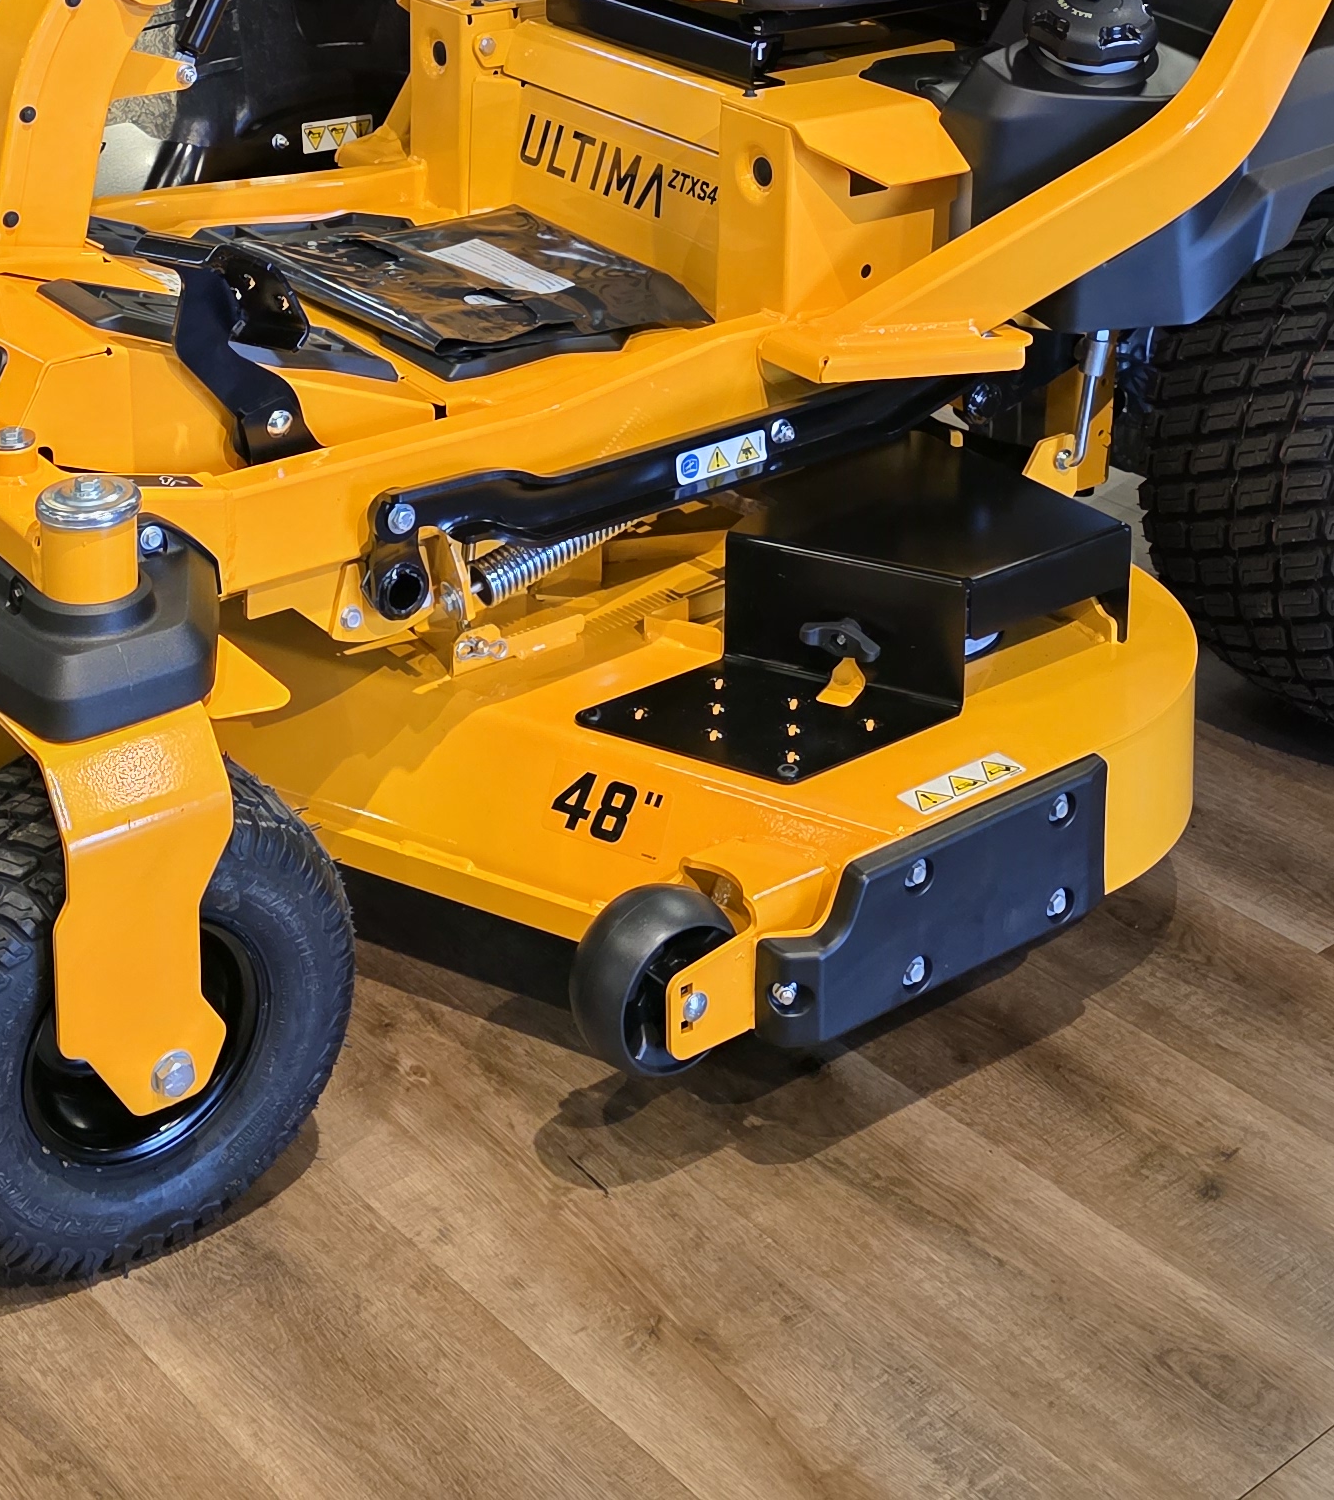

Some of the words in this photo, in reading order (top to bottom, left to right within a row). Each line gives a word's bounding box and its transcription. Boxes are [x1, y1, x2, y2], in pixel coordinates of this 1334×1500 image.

[520, 113, 664, 219] ULTIMA
[667, 169, 719, 205] ZTXS4
[551, 771, 664, 843] 48"
